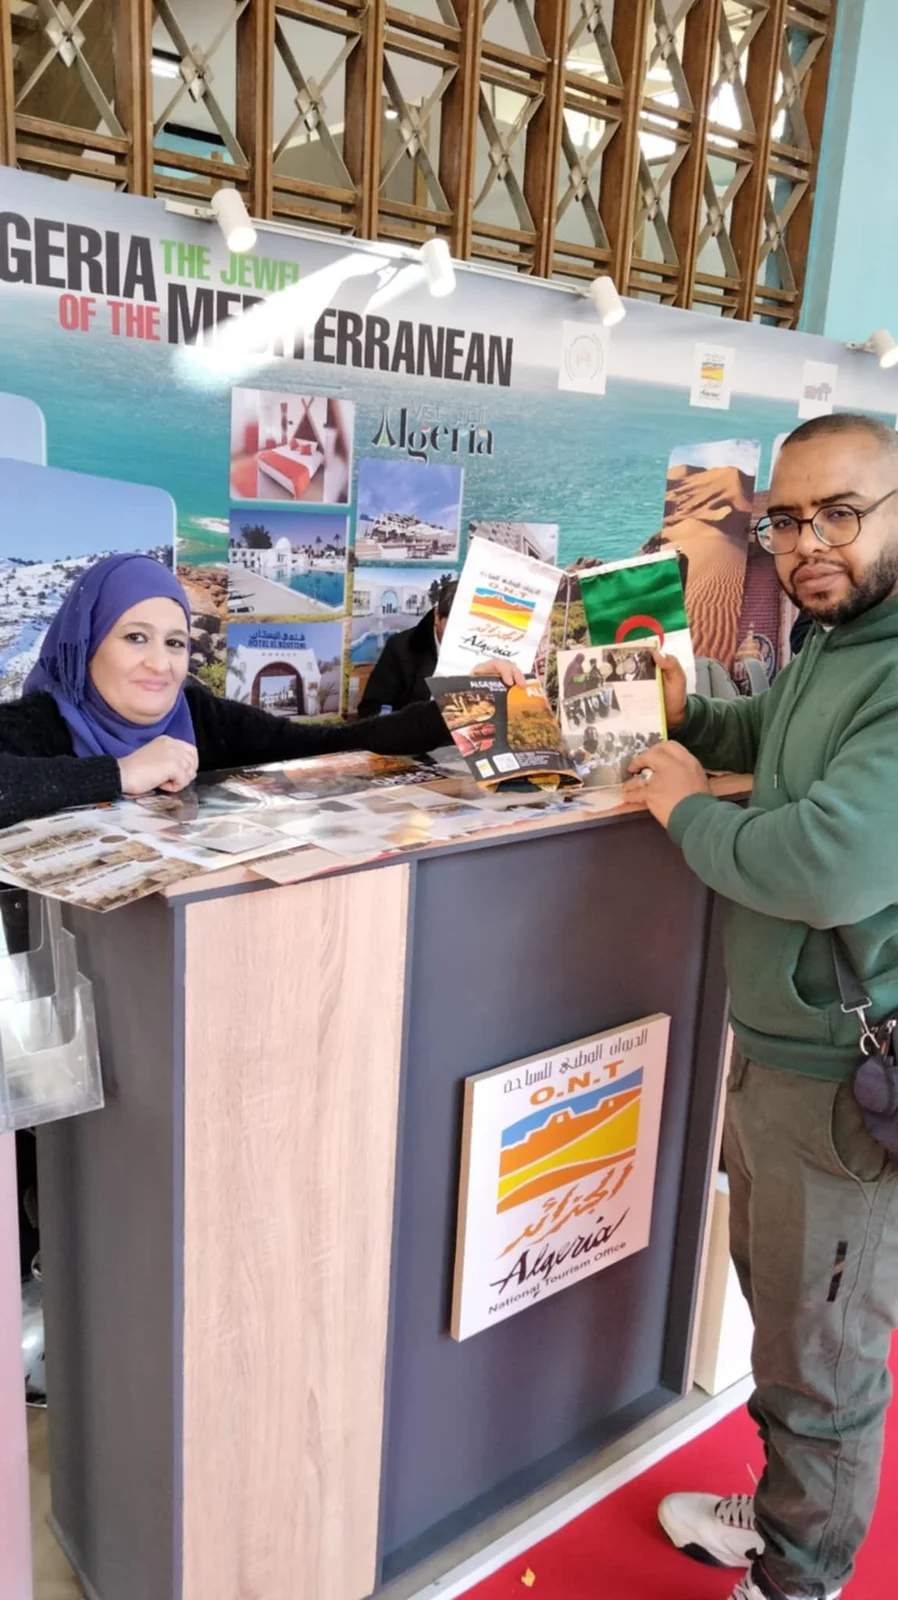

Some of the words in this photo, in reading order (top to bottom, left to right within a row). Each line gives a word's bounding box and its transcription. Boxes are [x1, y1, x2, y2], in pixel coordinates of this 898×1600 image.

[0, 211, 156, 302] GERIA
[161, 239, 211, 281] THE
[59, 293, 97, 332] OF
[107, 301, 161, 341] THE
[167, 282, 514, 387] MEERRANEAN
[371, 407, 494, 463] Algeria
[460, 634, 521, 657] Algeria
[559, 1043, 604, 1074] الوطني
[609, 1028, 648, 1056] الديوان
[529, 1058, 624, 1106] O.N.T
[496, 1161, 635, 1260] الجزائر
[488, 1283, 540, 1315] National
[544, 1259, 591, 1286] Tourism
[594, 1241, 627, 1261] Office
[489, 1206, 631, 1298] Algeria
